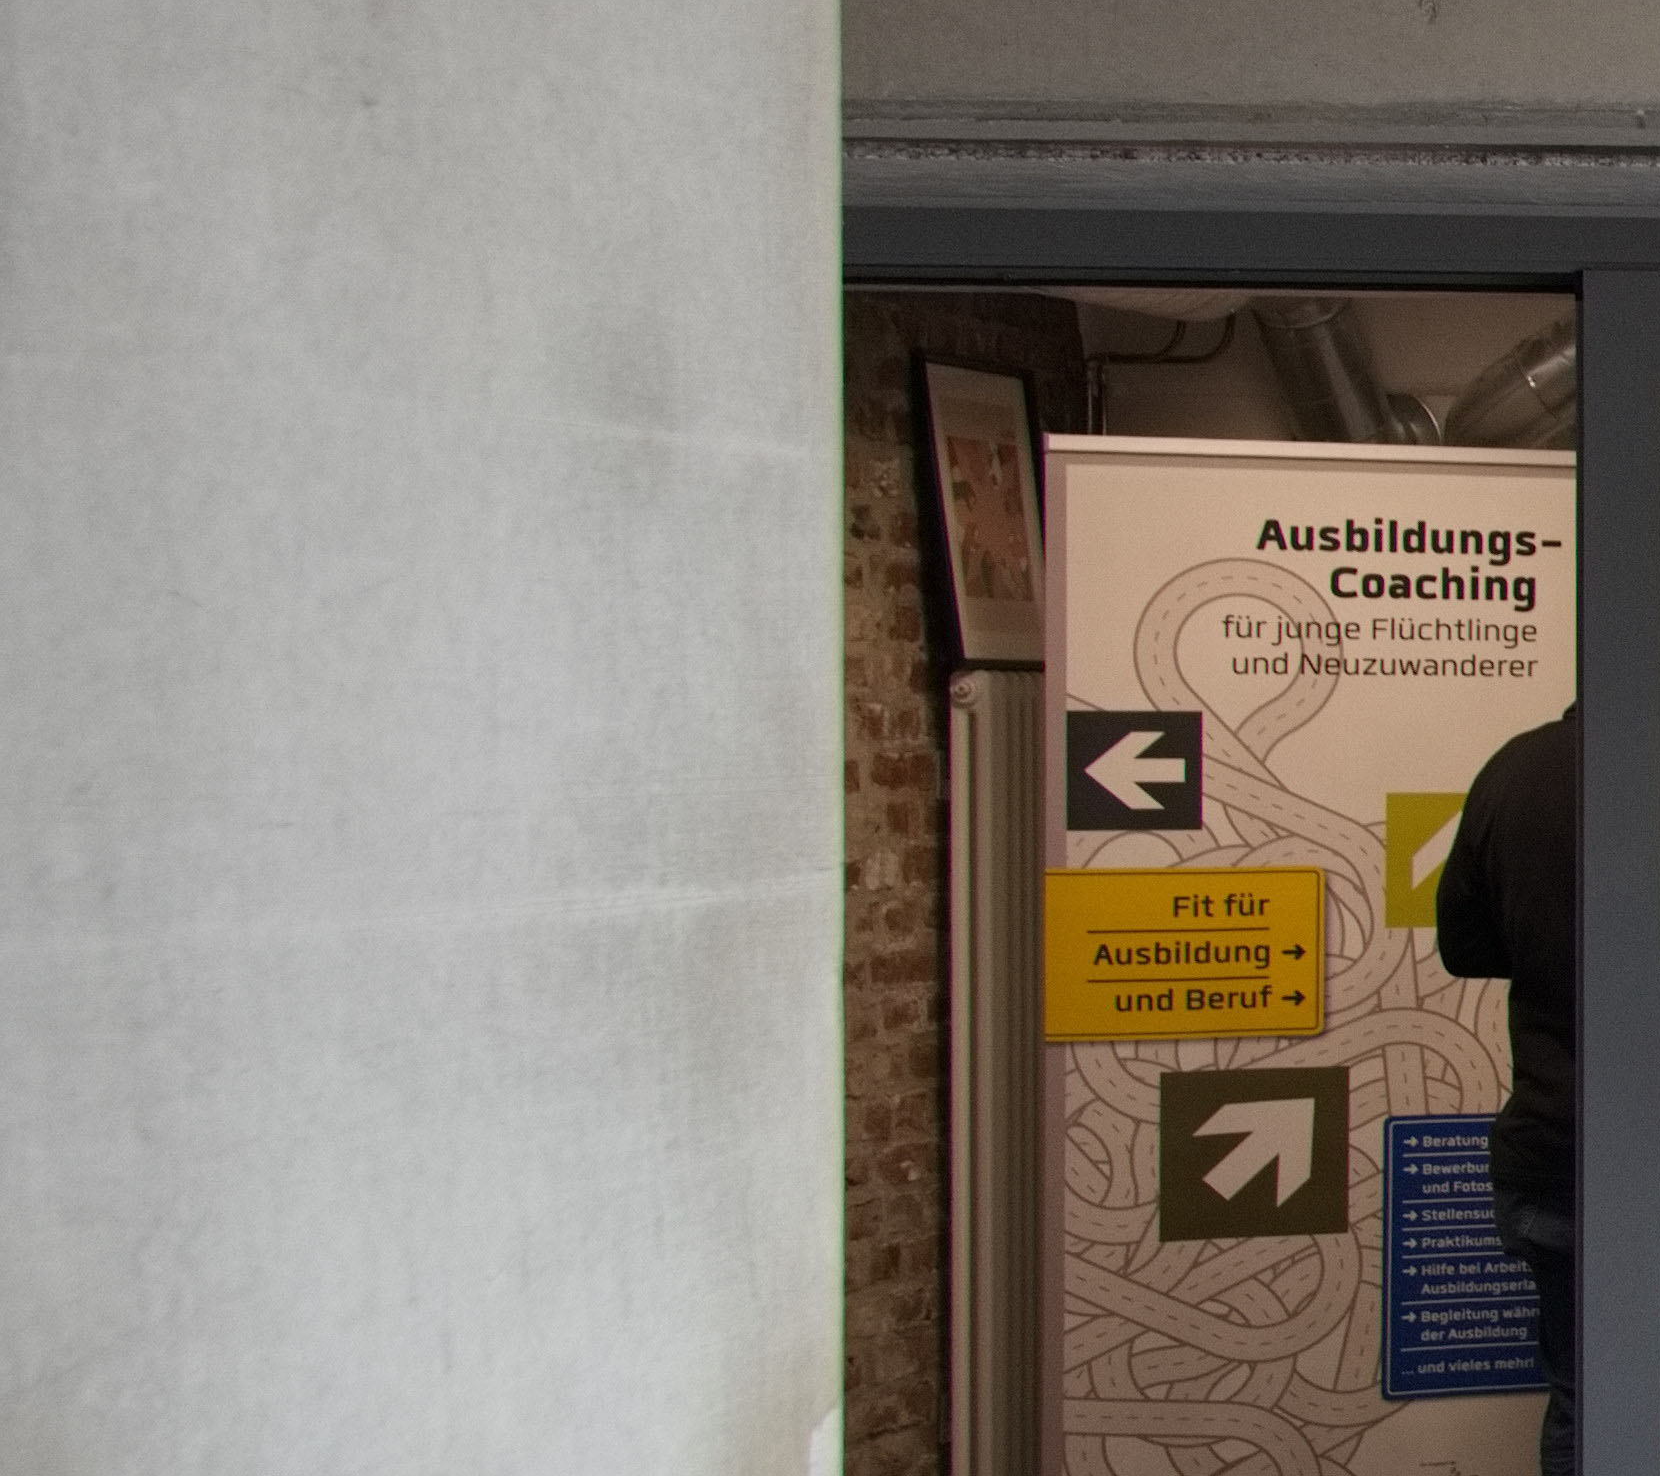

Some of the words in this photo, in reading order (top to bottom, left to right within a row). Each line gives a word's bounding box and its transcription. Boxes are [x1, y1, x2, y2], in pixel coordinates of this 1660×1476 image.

[1256, 519, 1563, 566] Ausbildungs-
[1330, 567, 1537, 612] Coaching
[1222, 614, 1267, 640] für
[1272, 616, 1362, 646] junge
[1372, 616, 1538, 647] Flüchtlinge
[1232, 653, 1289, 676] und
[1301, 654, 1539, 679] Neuzuwanderer
[1173, 895, 1213, 918] Fit
[1223, 892, 1270, 917] für
[1093, 941, 1270, 969] Ausbildung
[1115, 987, 1174, 1012] und
[1186, 985, 1274, 1011] Beruf
[1422, 1136, 1488, 1149] Beratung
[1422, 1182, 1449, 1193] und
[1421, 1265, 1455, 1276] Hilfe
[1459, 1264, 1481, 1274] bei
[1421, 1309, 1498, 1324] Begleitung
[1421, 1330, 1445, 1341] der
[1448, 1326, 1527, 1339] Ausbildung
[1418, 1361, 1445, 1373] und
[1449, 1359, 1491, 1371] vieles
